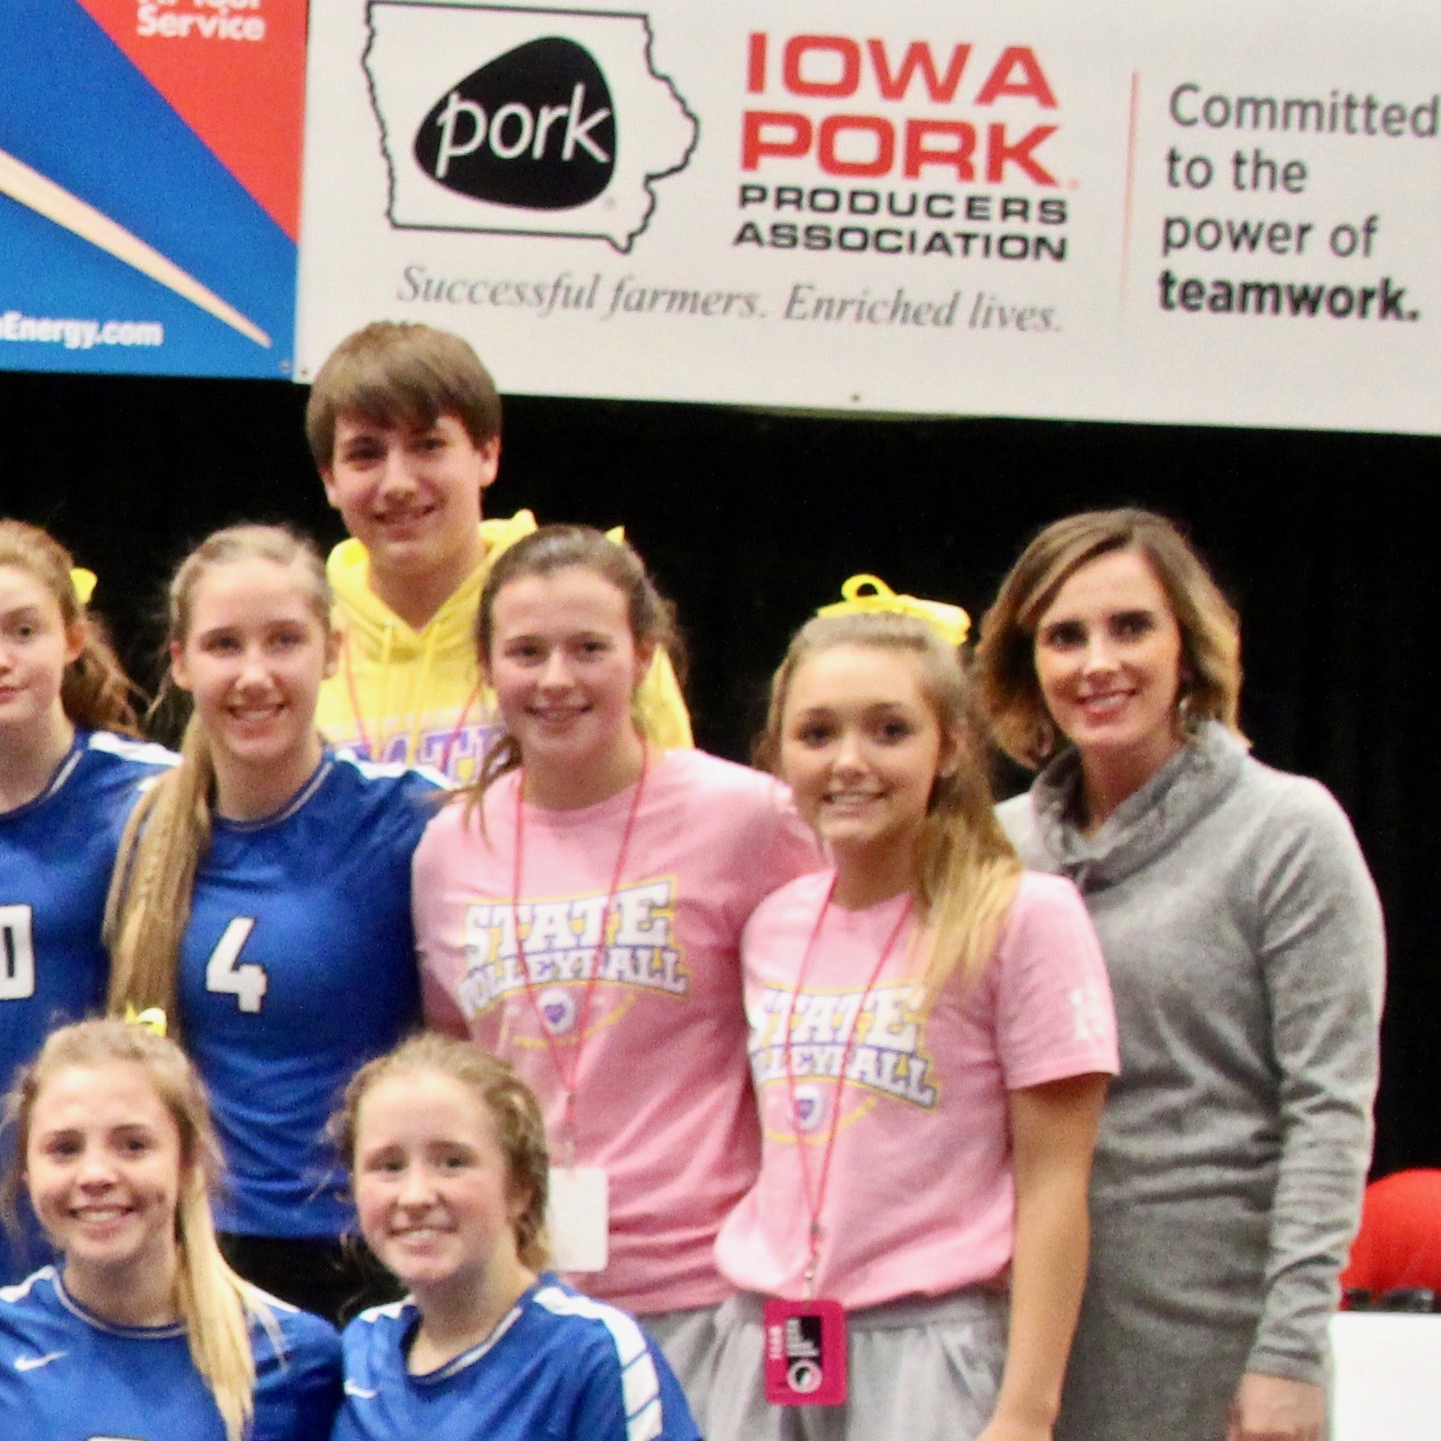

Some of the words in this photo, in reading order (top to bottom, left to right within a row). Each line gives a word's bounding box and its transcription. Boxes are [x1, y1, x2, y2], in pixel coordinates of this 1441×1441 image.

[136, 3, 266, 41] Service
[746, 32, 1059, 109] IOWA
[434, 82, 611, 179] pork
[1169, 82, 1439, 138] Committed
[741, 110, 1061, 187] PORK
[1166, 147, 1214, 189] to
[1231, 149, 1309, 193] the
[738, 184, 1068, 226] PRODUCERS
[733, 221, 1067, 262] ASSOCIATION
[1162, 214, 1312, 258] power
[1329, 213, 1380, 258] of
[396, 265, 602, 318] Successful
[600, 274, 768, 322] farmers.
[783, 283, 963, 327] Enriched
[968, 291, 1063, 333] lives.
[1158, 269, 1420, 322] teamwork.
[464, 879, 671, 972] STATE
[206, 916, 268, 1013] 4
